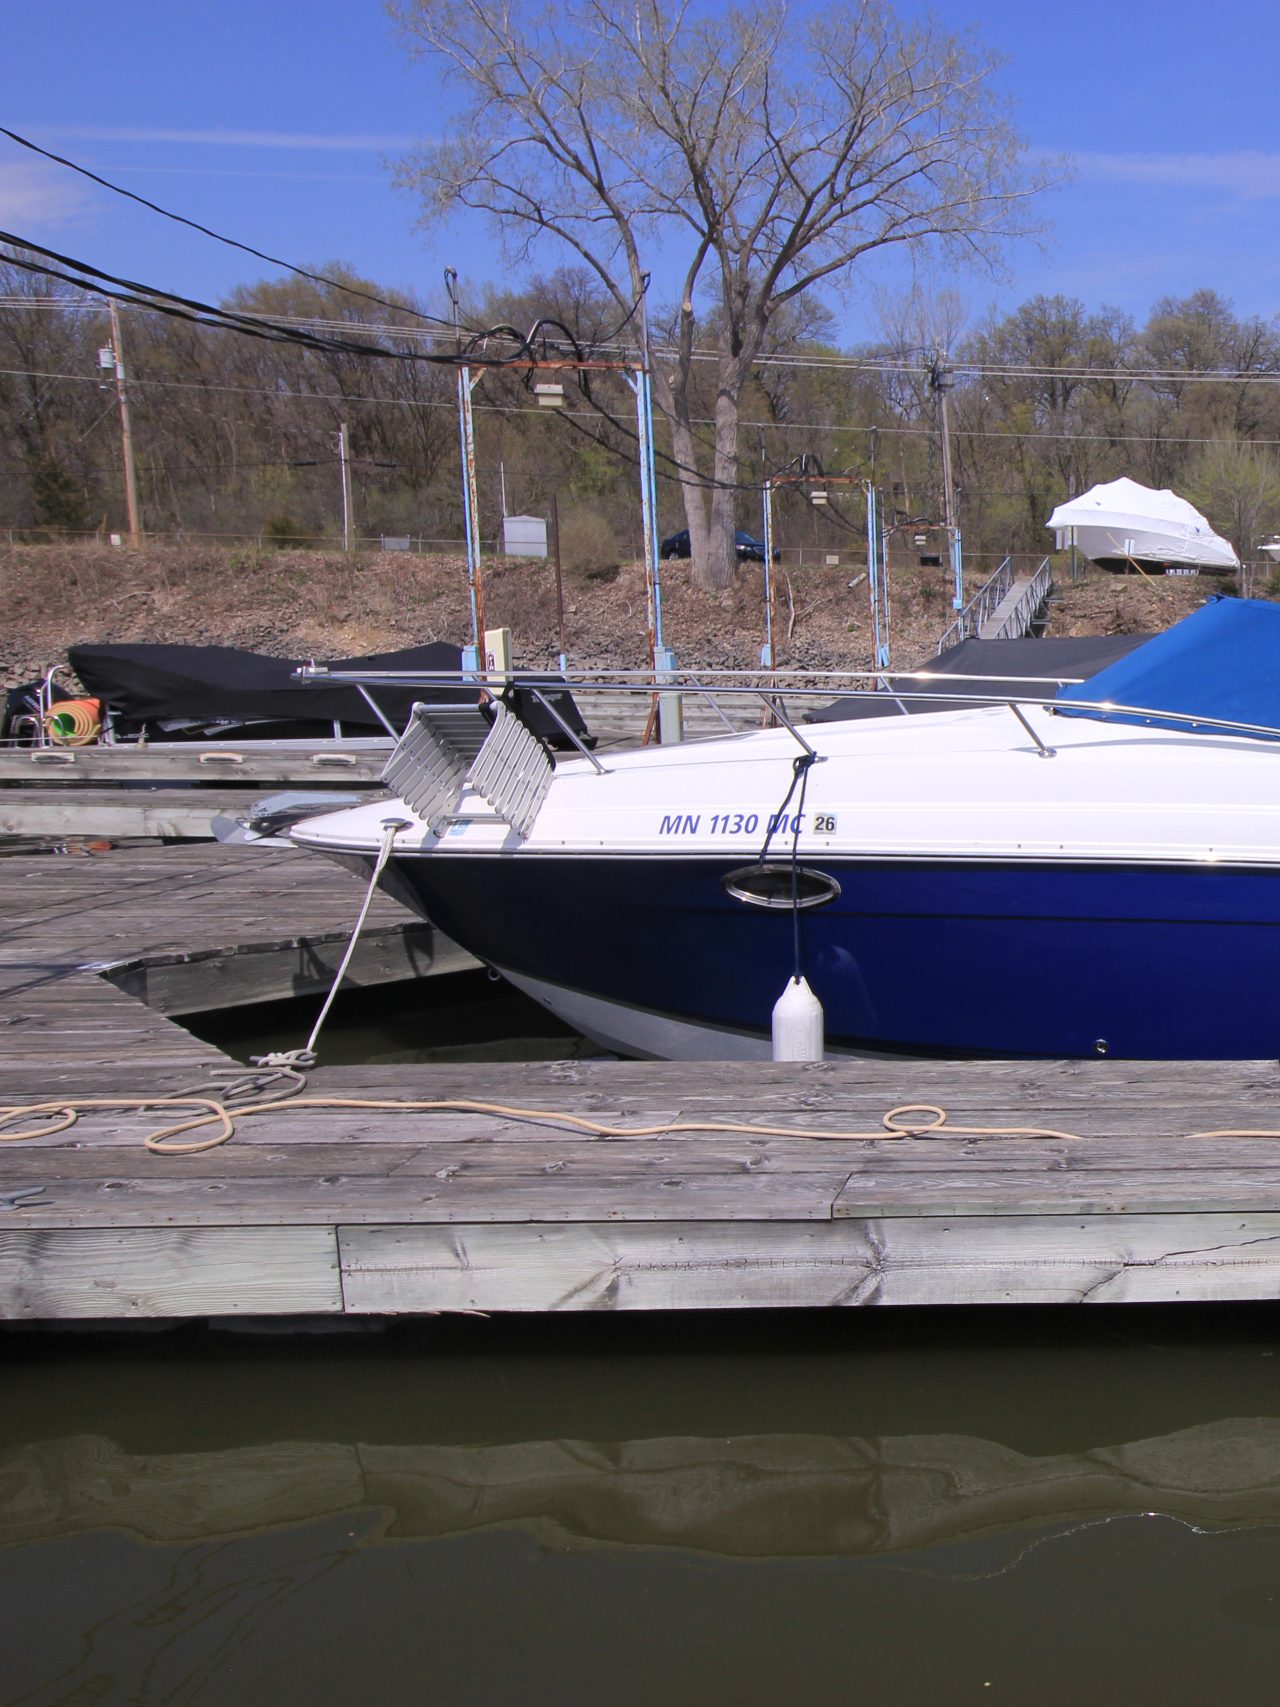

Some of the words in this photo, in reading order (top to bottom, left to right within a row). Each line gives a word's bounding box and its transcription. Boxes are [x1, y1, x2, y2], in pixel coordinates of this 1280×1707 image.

[658, 815, 701, 835] MN
[710, 814, 759, 834] 1130
[766, 814, 806, 834] MC
[814, 816, 836, 832] 26
